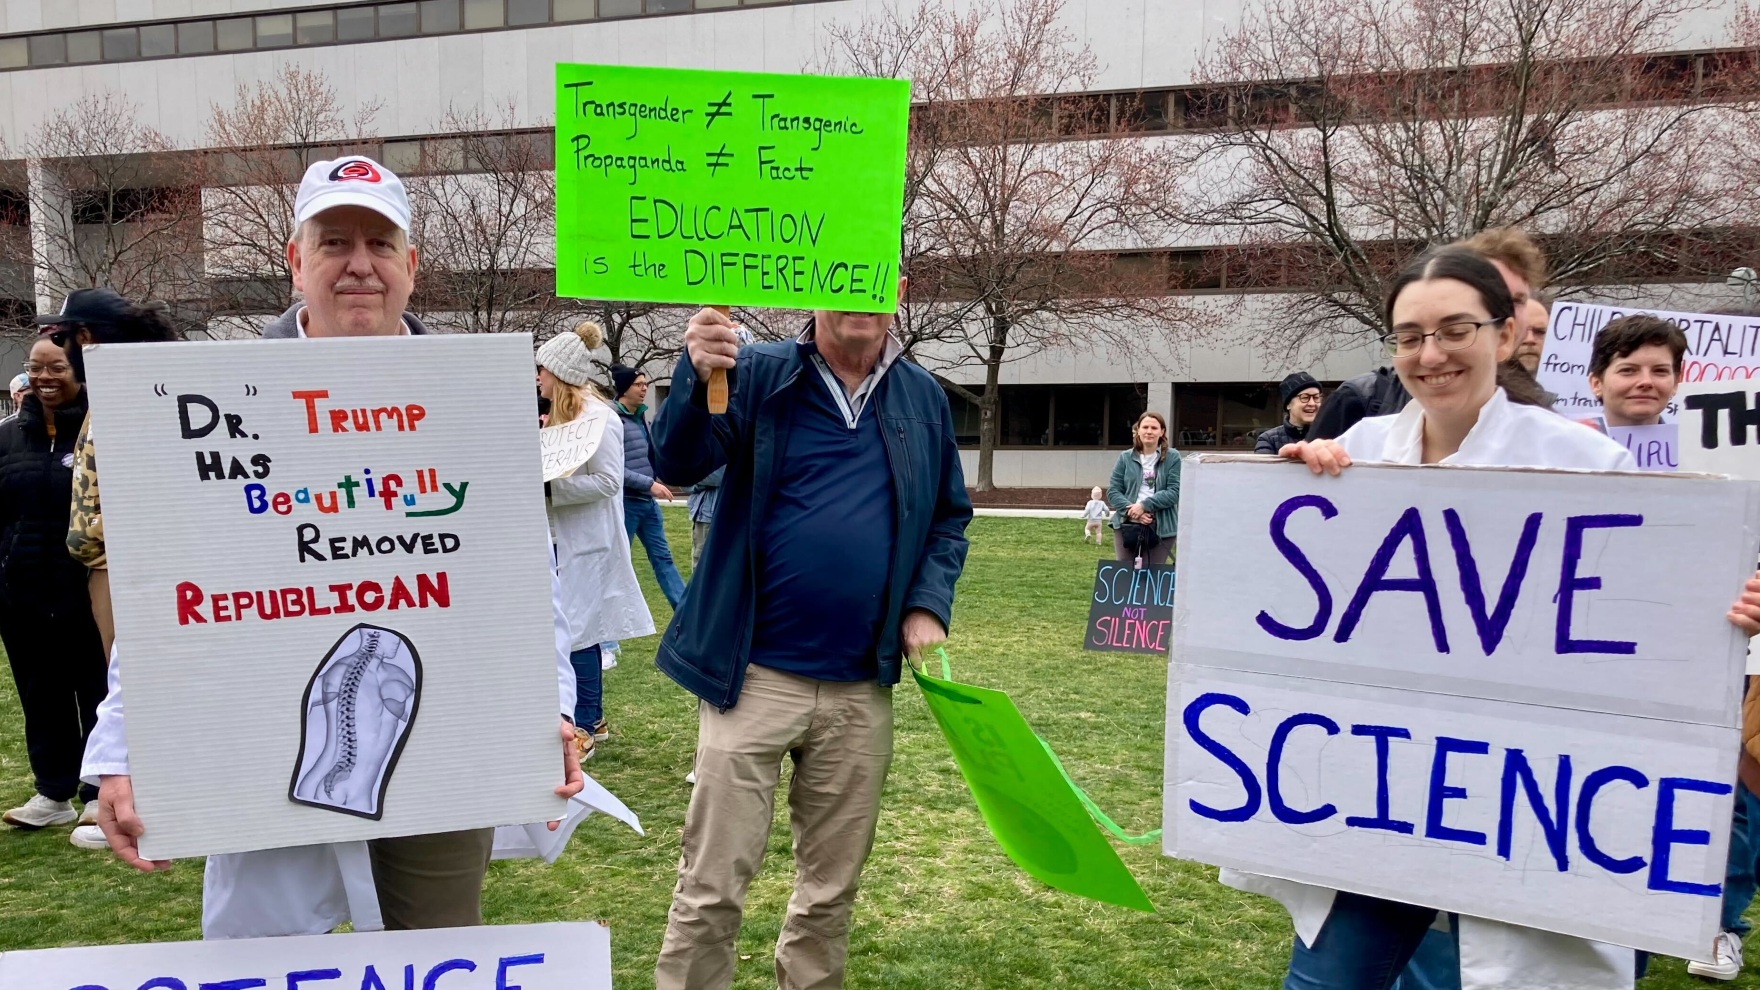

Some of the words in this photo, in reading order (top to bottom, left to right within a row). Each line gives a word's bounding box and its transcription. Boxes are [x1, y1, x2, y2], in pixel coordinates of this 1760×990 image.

[564, 81, 693, 139] Transgender
[752, 94, 863, 149] Transgenic
[571, 134, 687, 184] Propaganda
[758, 146, 813, 179] Fact
[630, 196, 825, 247] EDUCATION
[584, 252, 609, 274] is
[629, 252, 668, 279] the
[684, 249, 890, 303] DIFFERENCE!!
[1543, 353, 1584, 375] from
[291, 390, 426, 434] TRUMP
[195, 451, 272, 482] HAS
[244, 468, 469, 517] Beautifully
[296, 523, 461, 562] REMOVED
[175, 571, 450, 625] REPUBLICAN
[1094, 565, 1175, 607] SCIENCE
[1255, 495, 1644, 656] SAVE
[1092, 616, 1170, 650] SILENCE
[1122, 606, 1147, 620] NOT
[1183, 692, 1732, 897] SCIENCE
